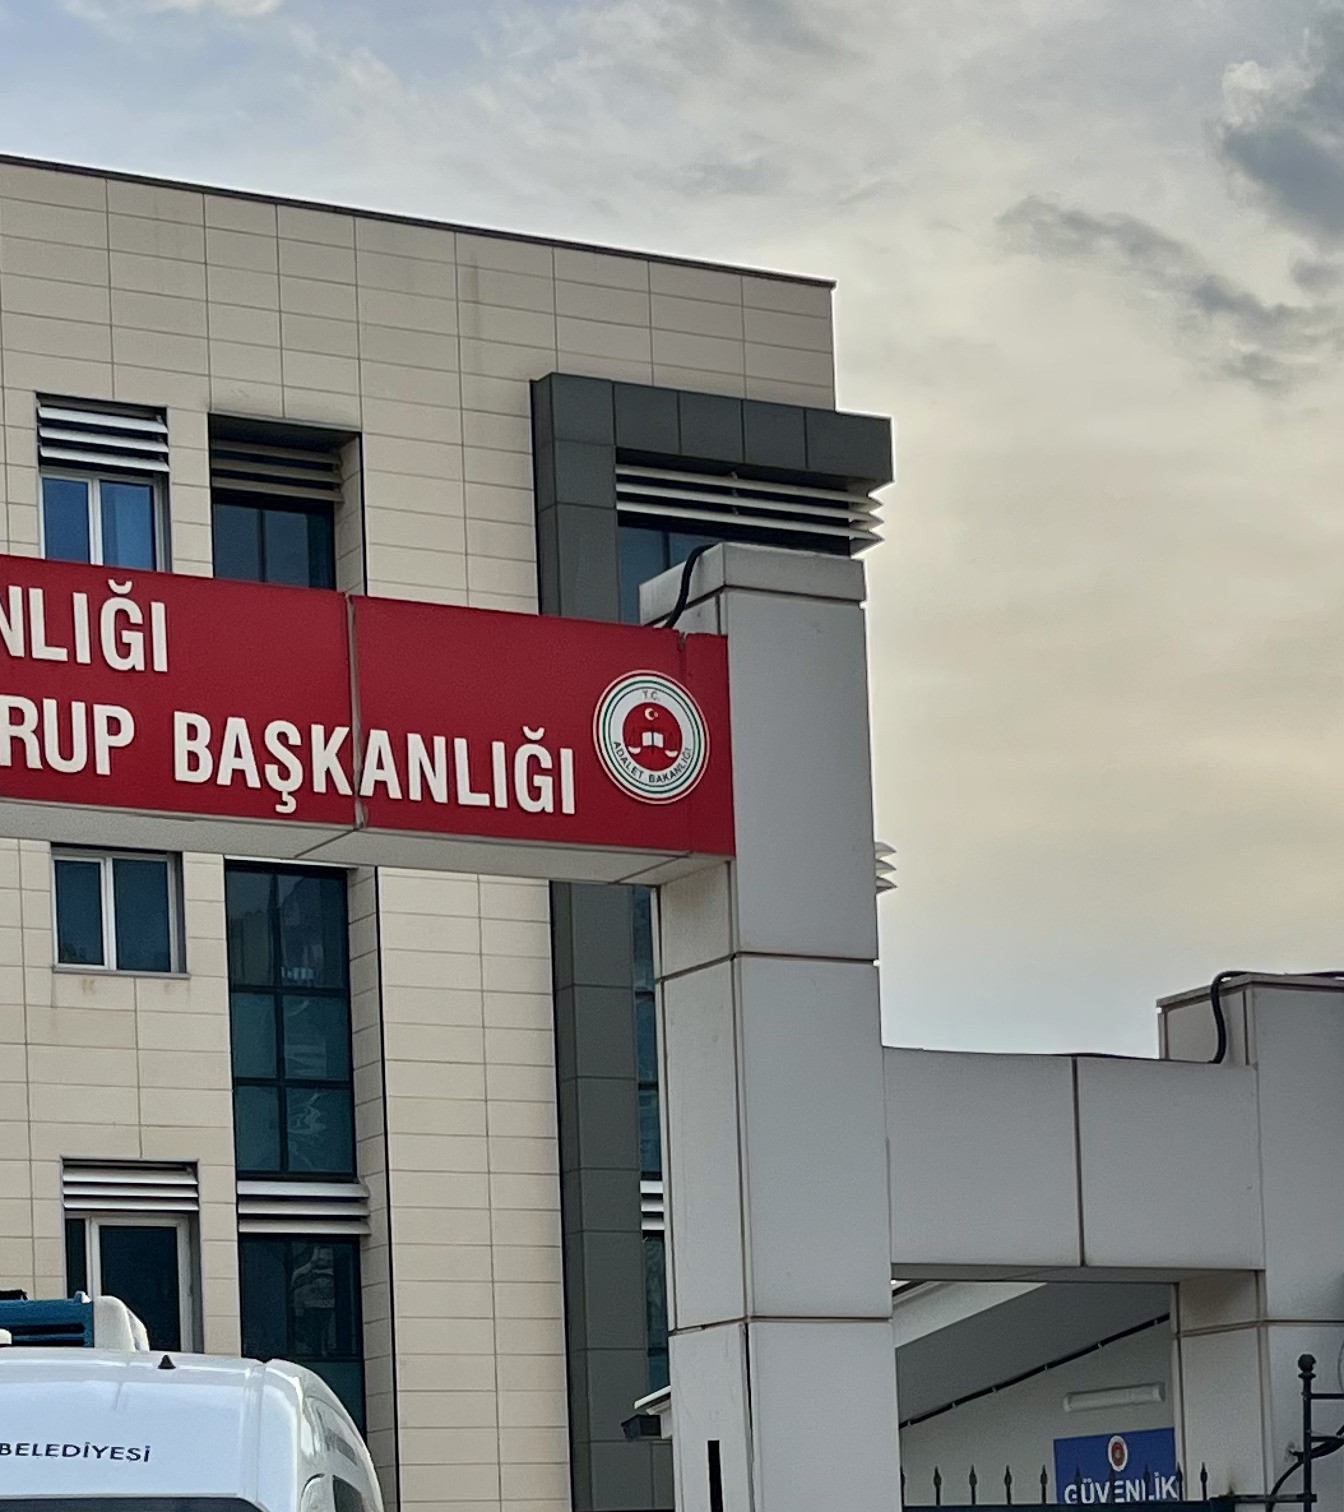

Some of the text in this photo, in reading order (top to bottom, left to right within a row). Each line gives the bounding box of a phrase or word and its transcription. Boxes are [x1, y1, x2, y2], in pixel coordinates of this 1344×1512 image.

[174, 711, 576, 816] BAŞKANLIĞI
[613, 741, 645, 780] ADALET
[1064, 1472, 1177, 1504] GÜVENLİK
